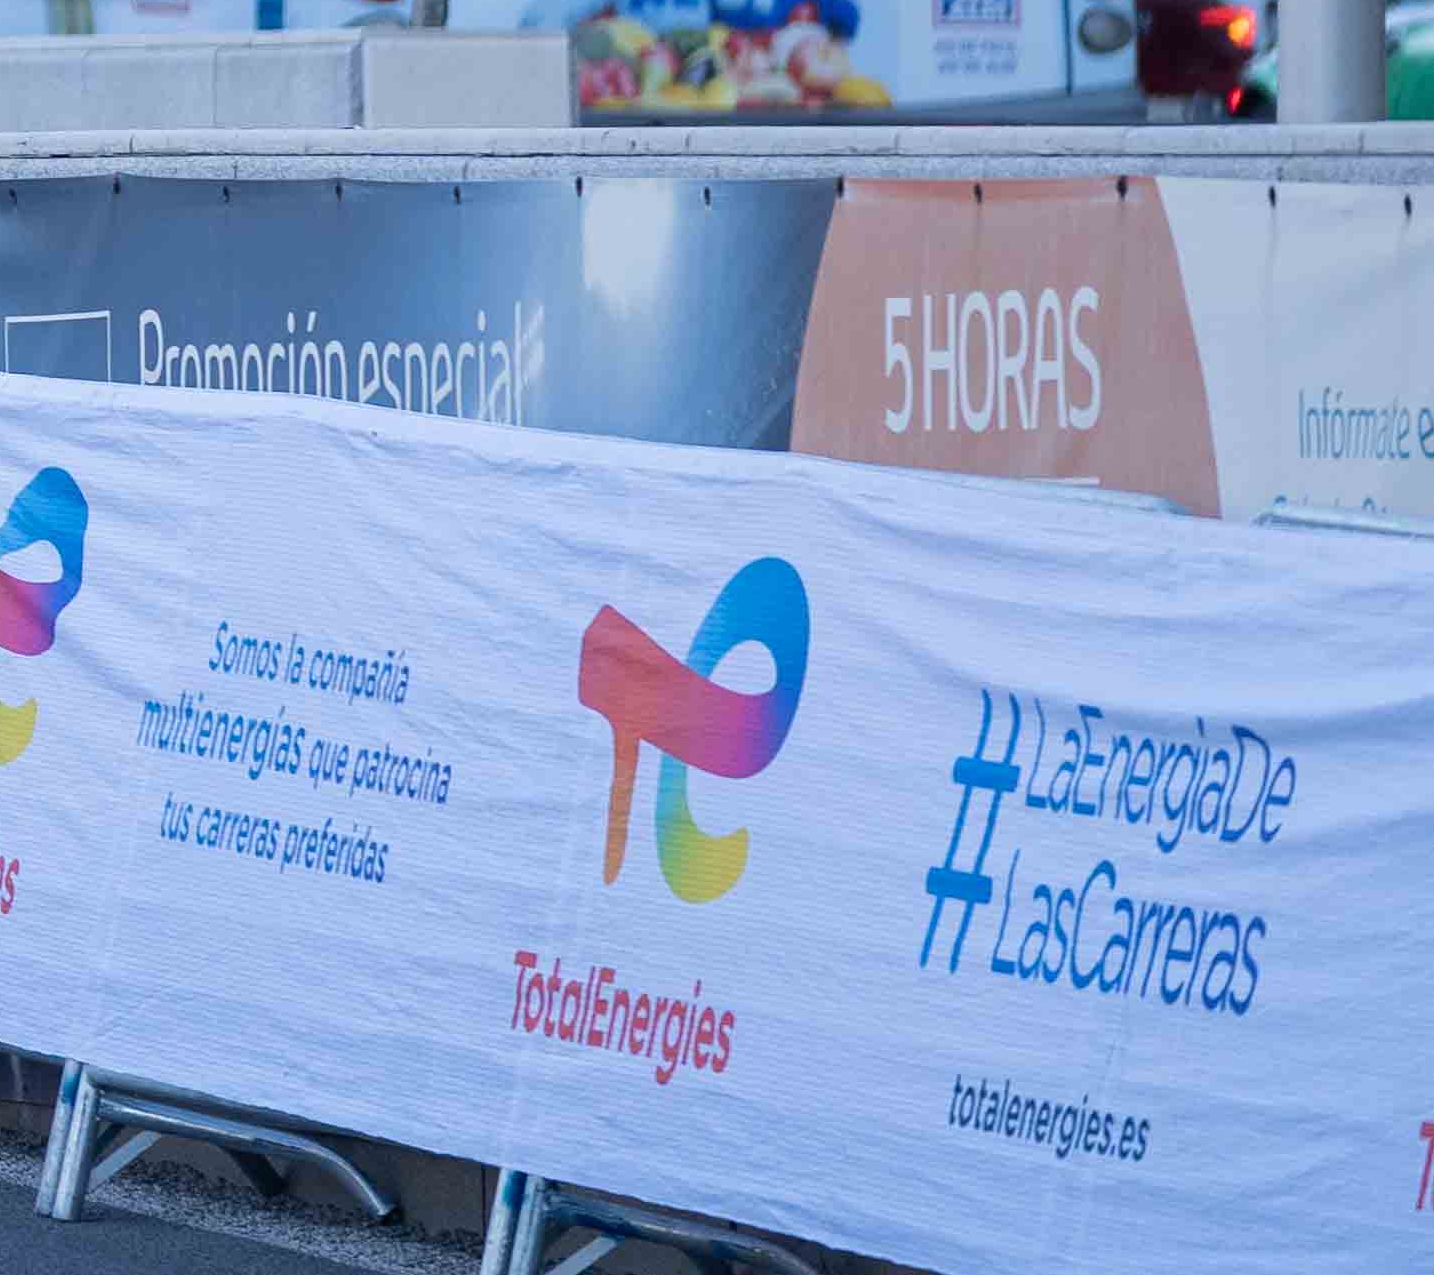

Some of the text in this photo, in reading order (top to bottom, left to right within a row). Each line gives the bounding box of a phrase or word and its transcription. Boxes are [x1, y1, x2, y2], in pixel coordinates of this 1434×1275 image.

[885, 286, 1102, 433] 5 HORAS
[1298, 386, 1410, 460] Infórmate
[208, 620, 410, 706] Somos la compañía
[137, 690, 453, 804] multienergías que patrocina
[160, 791, 389, 884] tus carreras preferidas
[990, 847, 1266, 1016] LasCarreras
[508, 948, 737, 1086] TotalEnergies
[948, 1072, 1151, 1163] totalenergies.es
